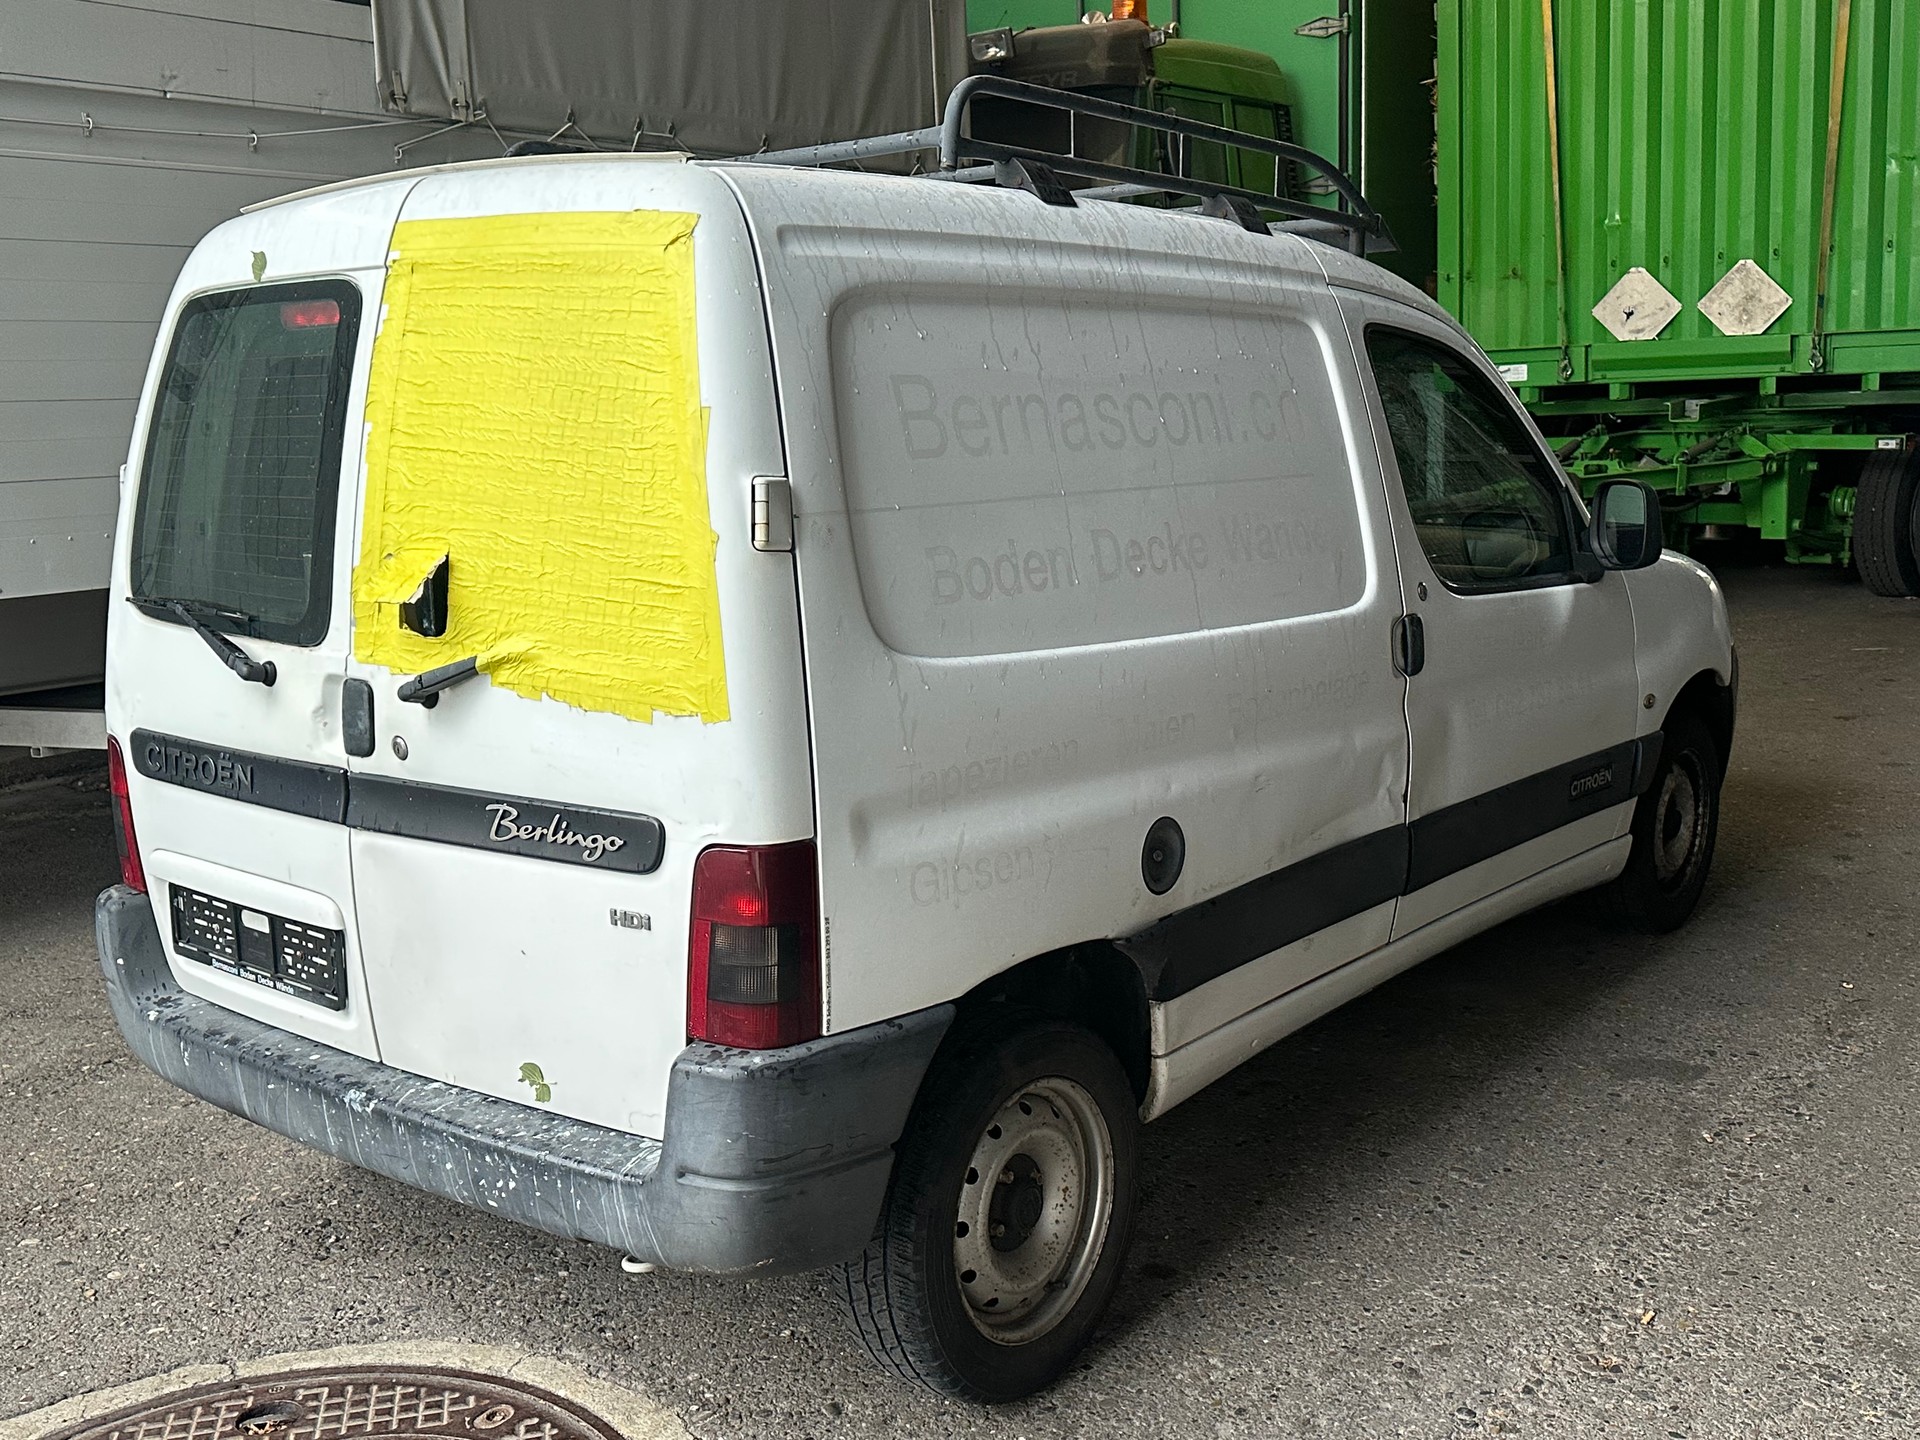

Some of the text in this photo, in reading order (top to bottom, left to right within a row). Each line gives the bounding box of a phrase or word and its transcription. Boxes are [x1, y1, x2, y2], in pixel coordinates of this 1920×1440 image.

[889, 374, 1306, 460] Bernasconi.ch
[924, 538, 1073, 606] Boden
[1090, 522, 1208, 583] Decke
[145, 744, 253, 794] CITROËN
[897, 738, 1079, 812] Tapezieren
[1571, 768, 1612, 796] CITROËN
[485, 802, 625, 861] Berlingo
[909, 845, 1034, 909] Gipsen
[610, 908, 651, 931] HDi
[211, 958, 238, 975] Bernasconi
[240, 967, 256, 981] Boden
[258, 974, 274, 987] Decke
